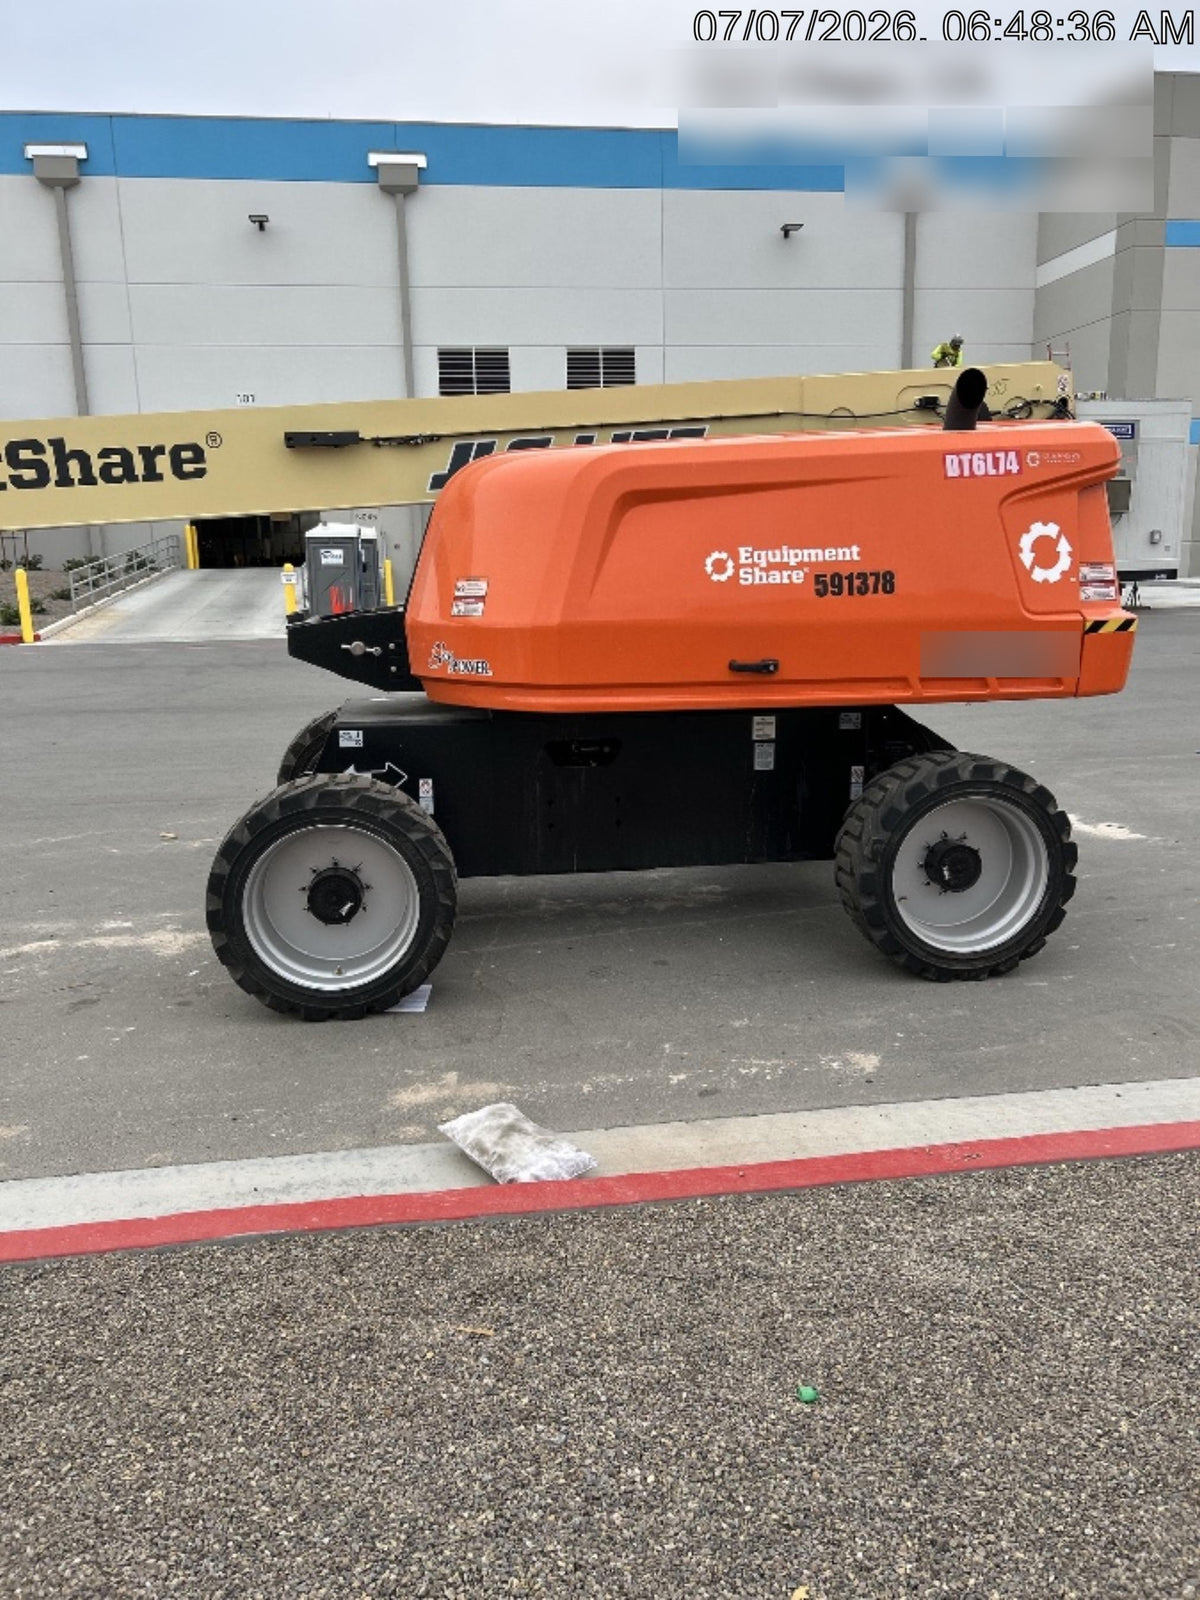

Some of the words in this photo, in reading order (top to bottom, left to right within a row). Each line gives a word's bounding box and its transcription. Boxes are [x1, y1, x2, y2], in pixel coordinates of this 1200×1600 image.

[0, 431, 223, 490] Share®
[945, 451, 1020, 477] DT6L74
[738, 545, 861, 568] Equipment
[739, 567, 805, 586] Share
[814, 570, 894, 598] 591378
